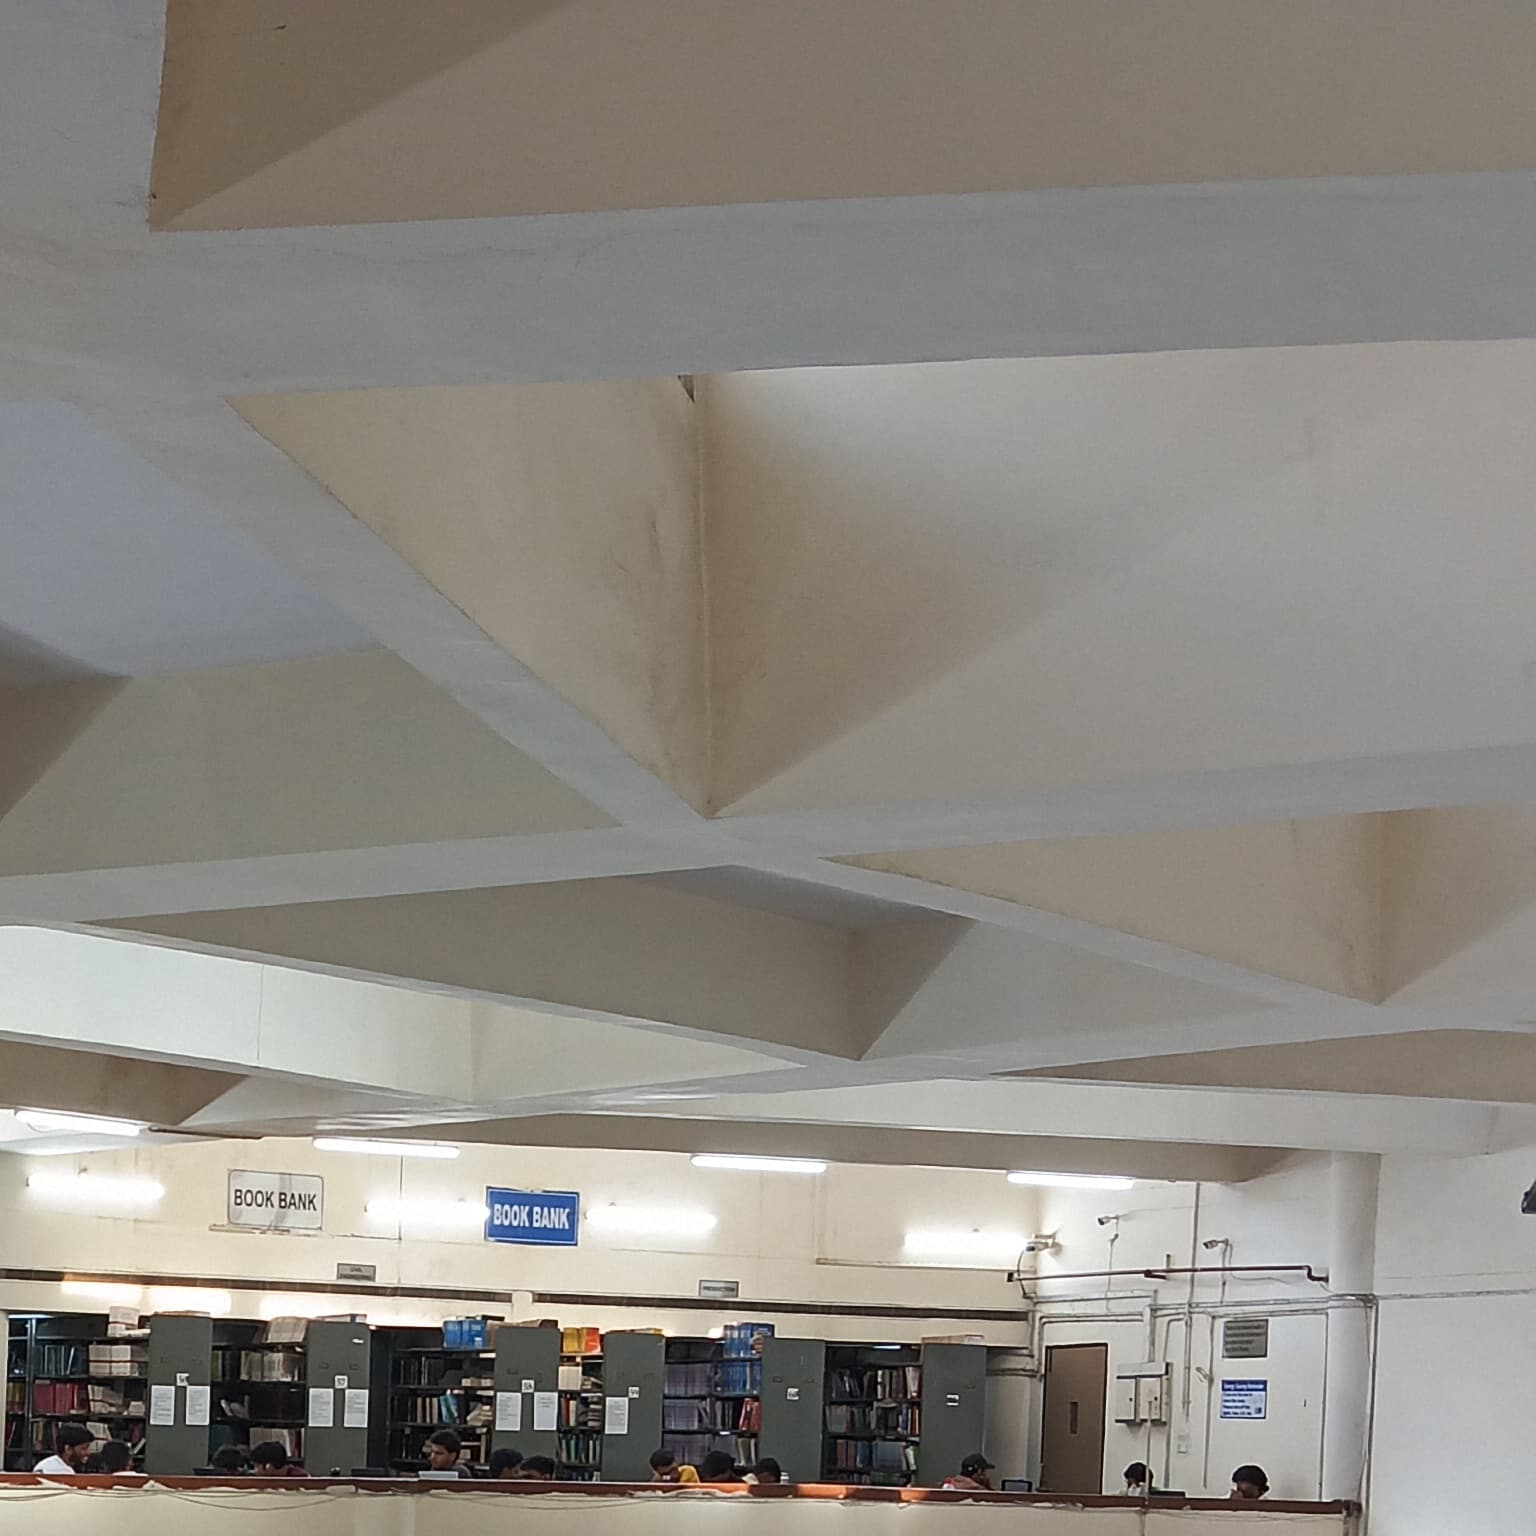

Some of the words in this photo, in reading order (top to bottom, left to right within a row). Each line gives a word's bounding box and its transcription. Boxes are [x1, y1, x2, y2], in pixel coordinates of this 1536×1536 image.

[234, 1189, 274, 1208] BOOK
[278, 1191, 317, 1211] BANK
[493, 1203, 530, 1227] BOOK
[532, 1206, 570, 1230] BANK
